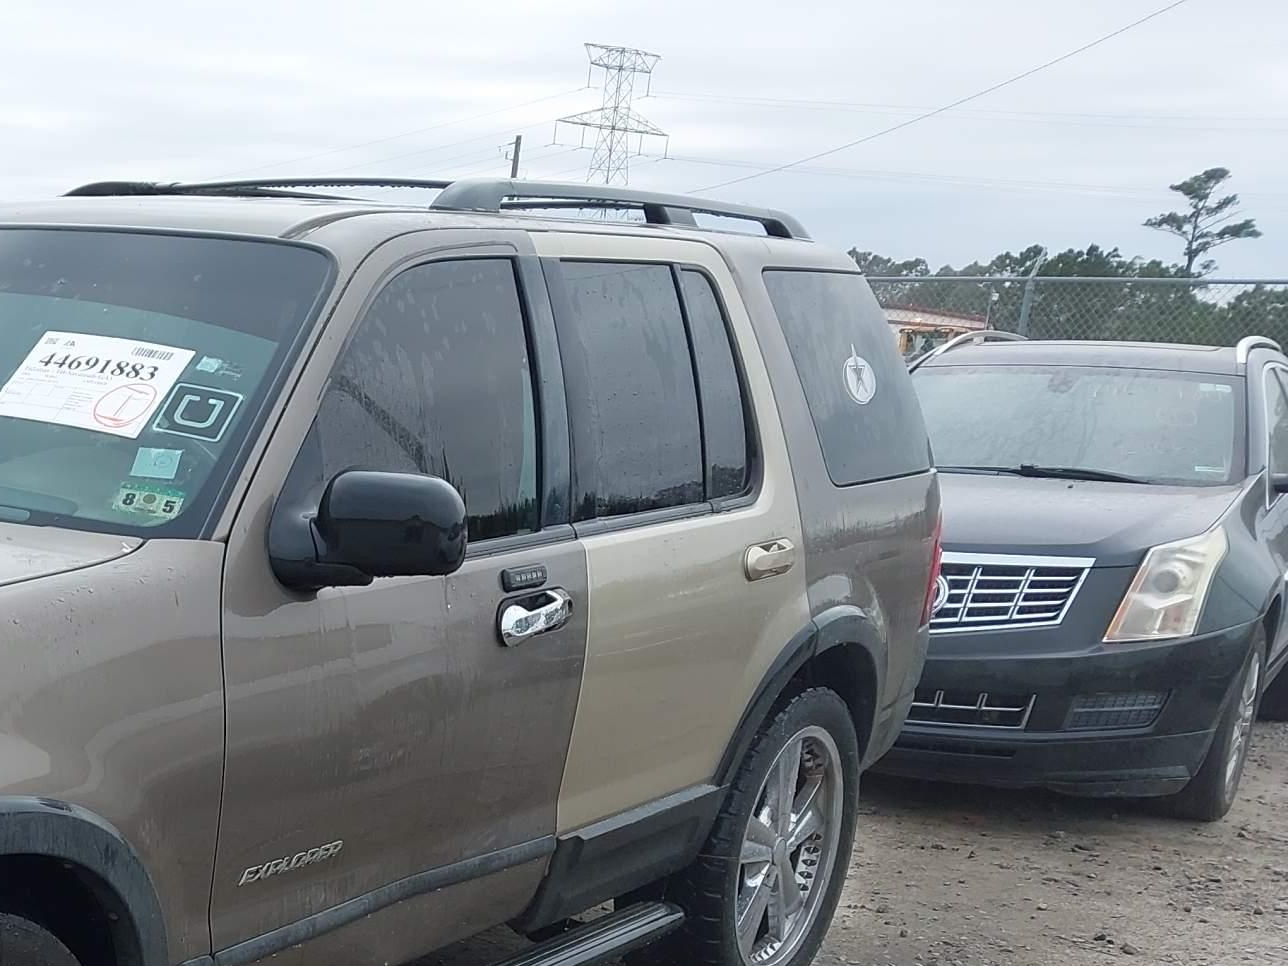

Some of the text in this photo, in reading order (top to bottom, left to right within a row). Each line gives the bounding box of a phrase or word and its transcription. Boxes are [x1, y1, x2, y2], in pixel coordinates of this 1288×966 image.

[39, 351, 159, 382] 44691883
[122, 492, 177, 514] 8 5
